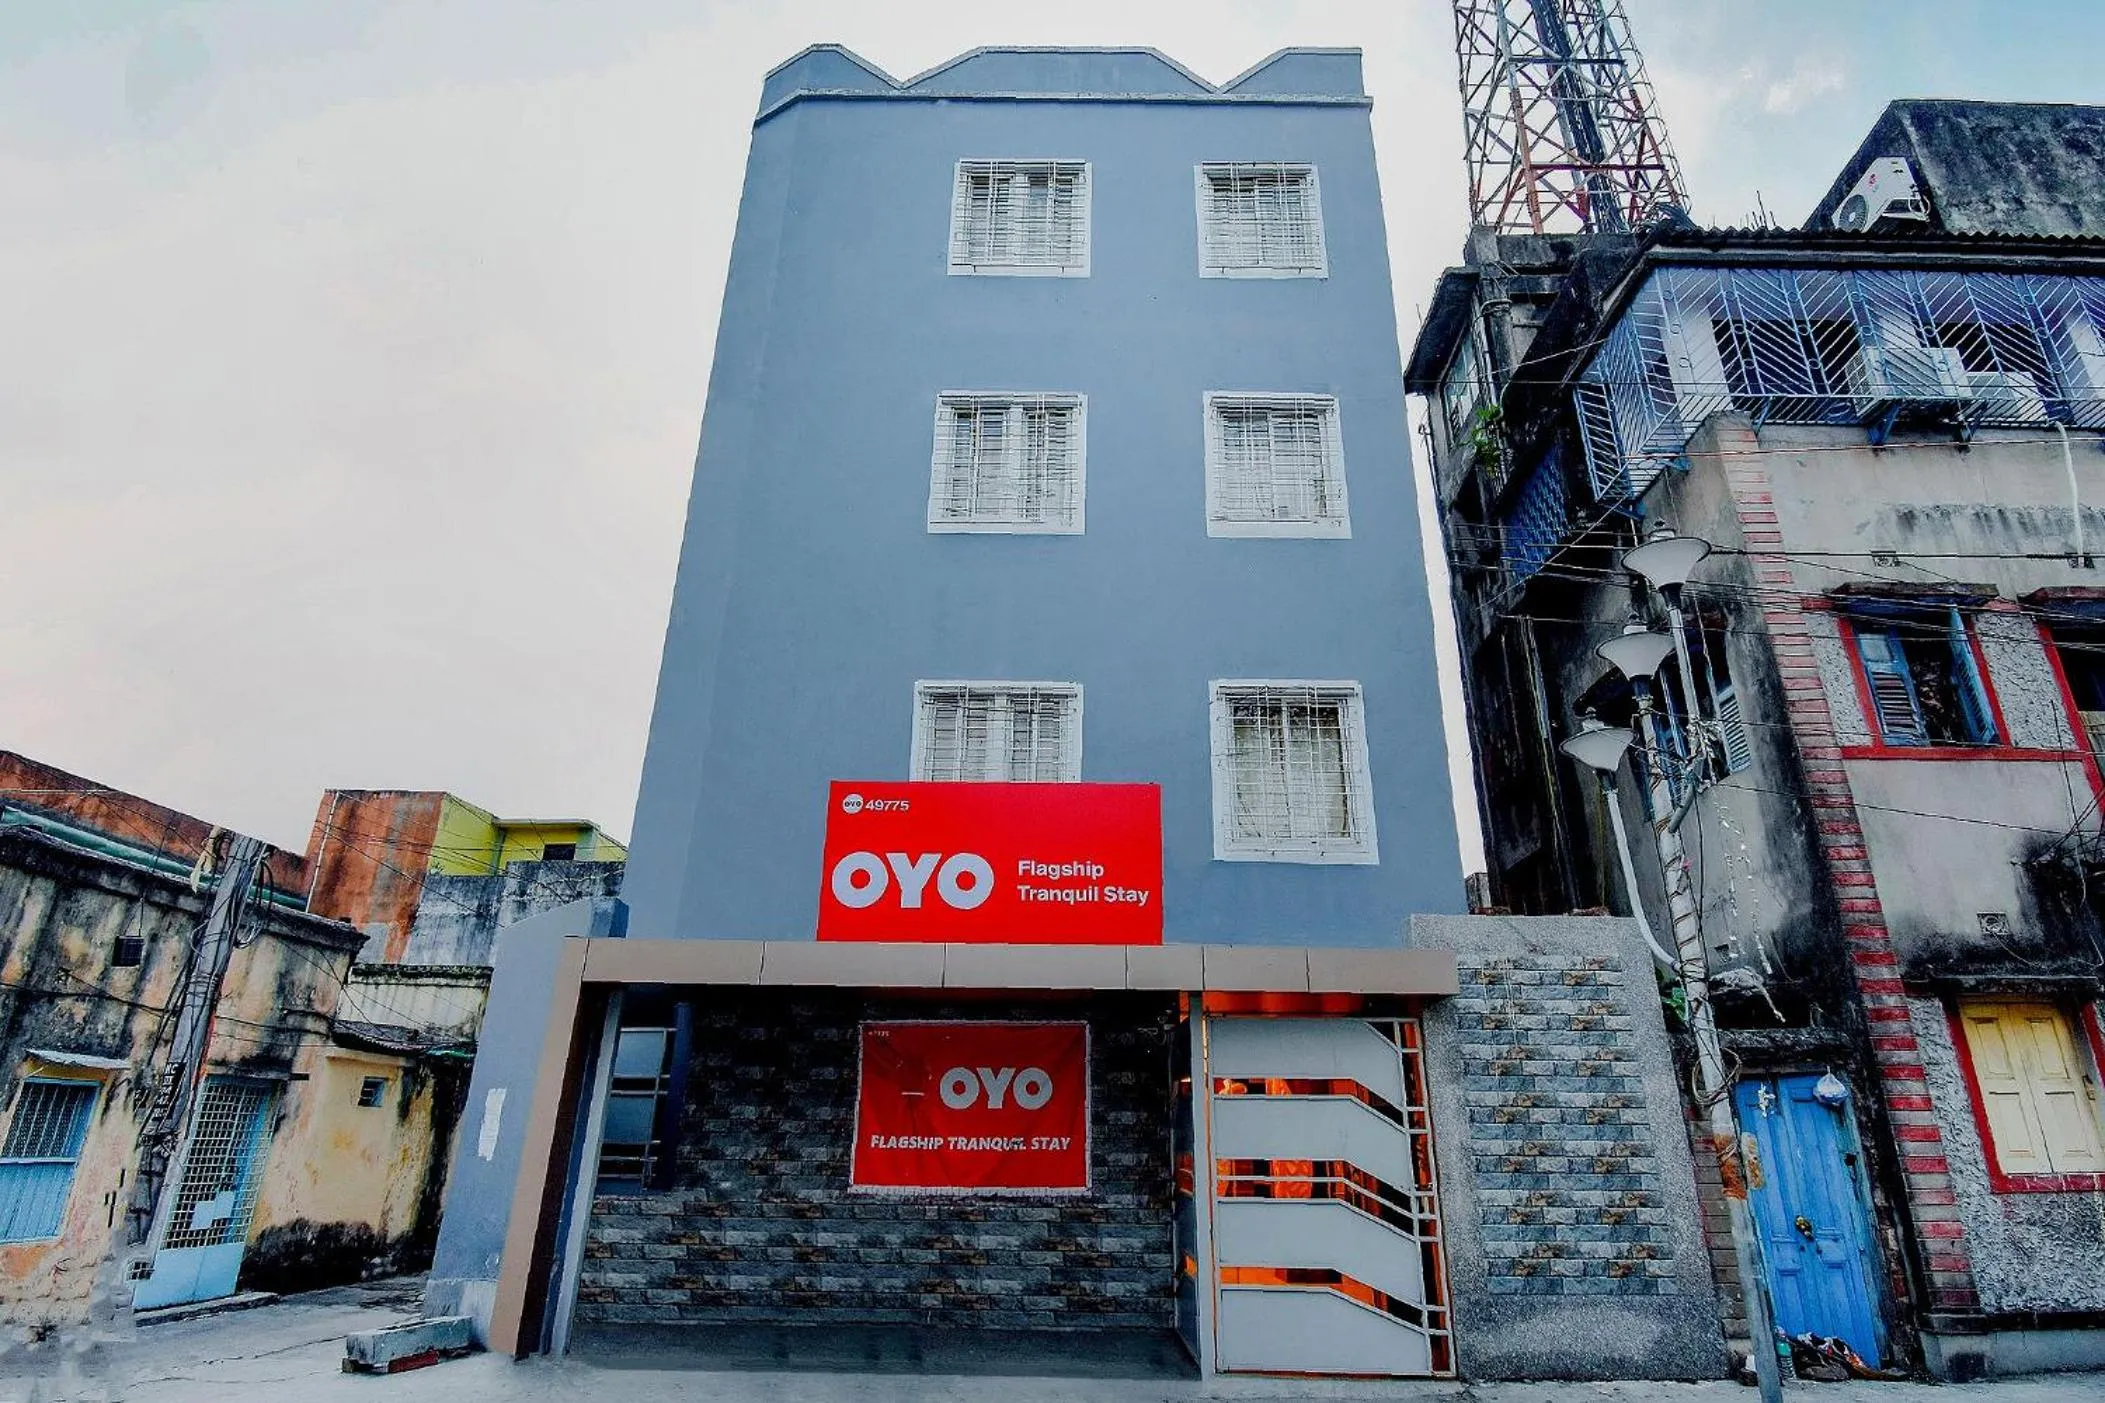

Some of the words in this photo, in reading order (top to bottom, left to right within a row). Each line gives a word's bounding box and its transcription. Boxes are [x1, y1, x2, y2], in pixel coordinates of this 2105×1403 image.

[865, 799, 910, 811] 49775
[831, 851, 995, 909] OYO
[1018, 860, 1105, 880] Flagship
[1016, 885, 1099, 905] Tranquil
[1103, 886, 1149, 906] Stay
[939, 1066, 1053, 1110] OYO
[870, 1134, 944, 1150] FLAGSHIP
[1031, 1137, 1071, 1150] STAY
